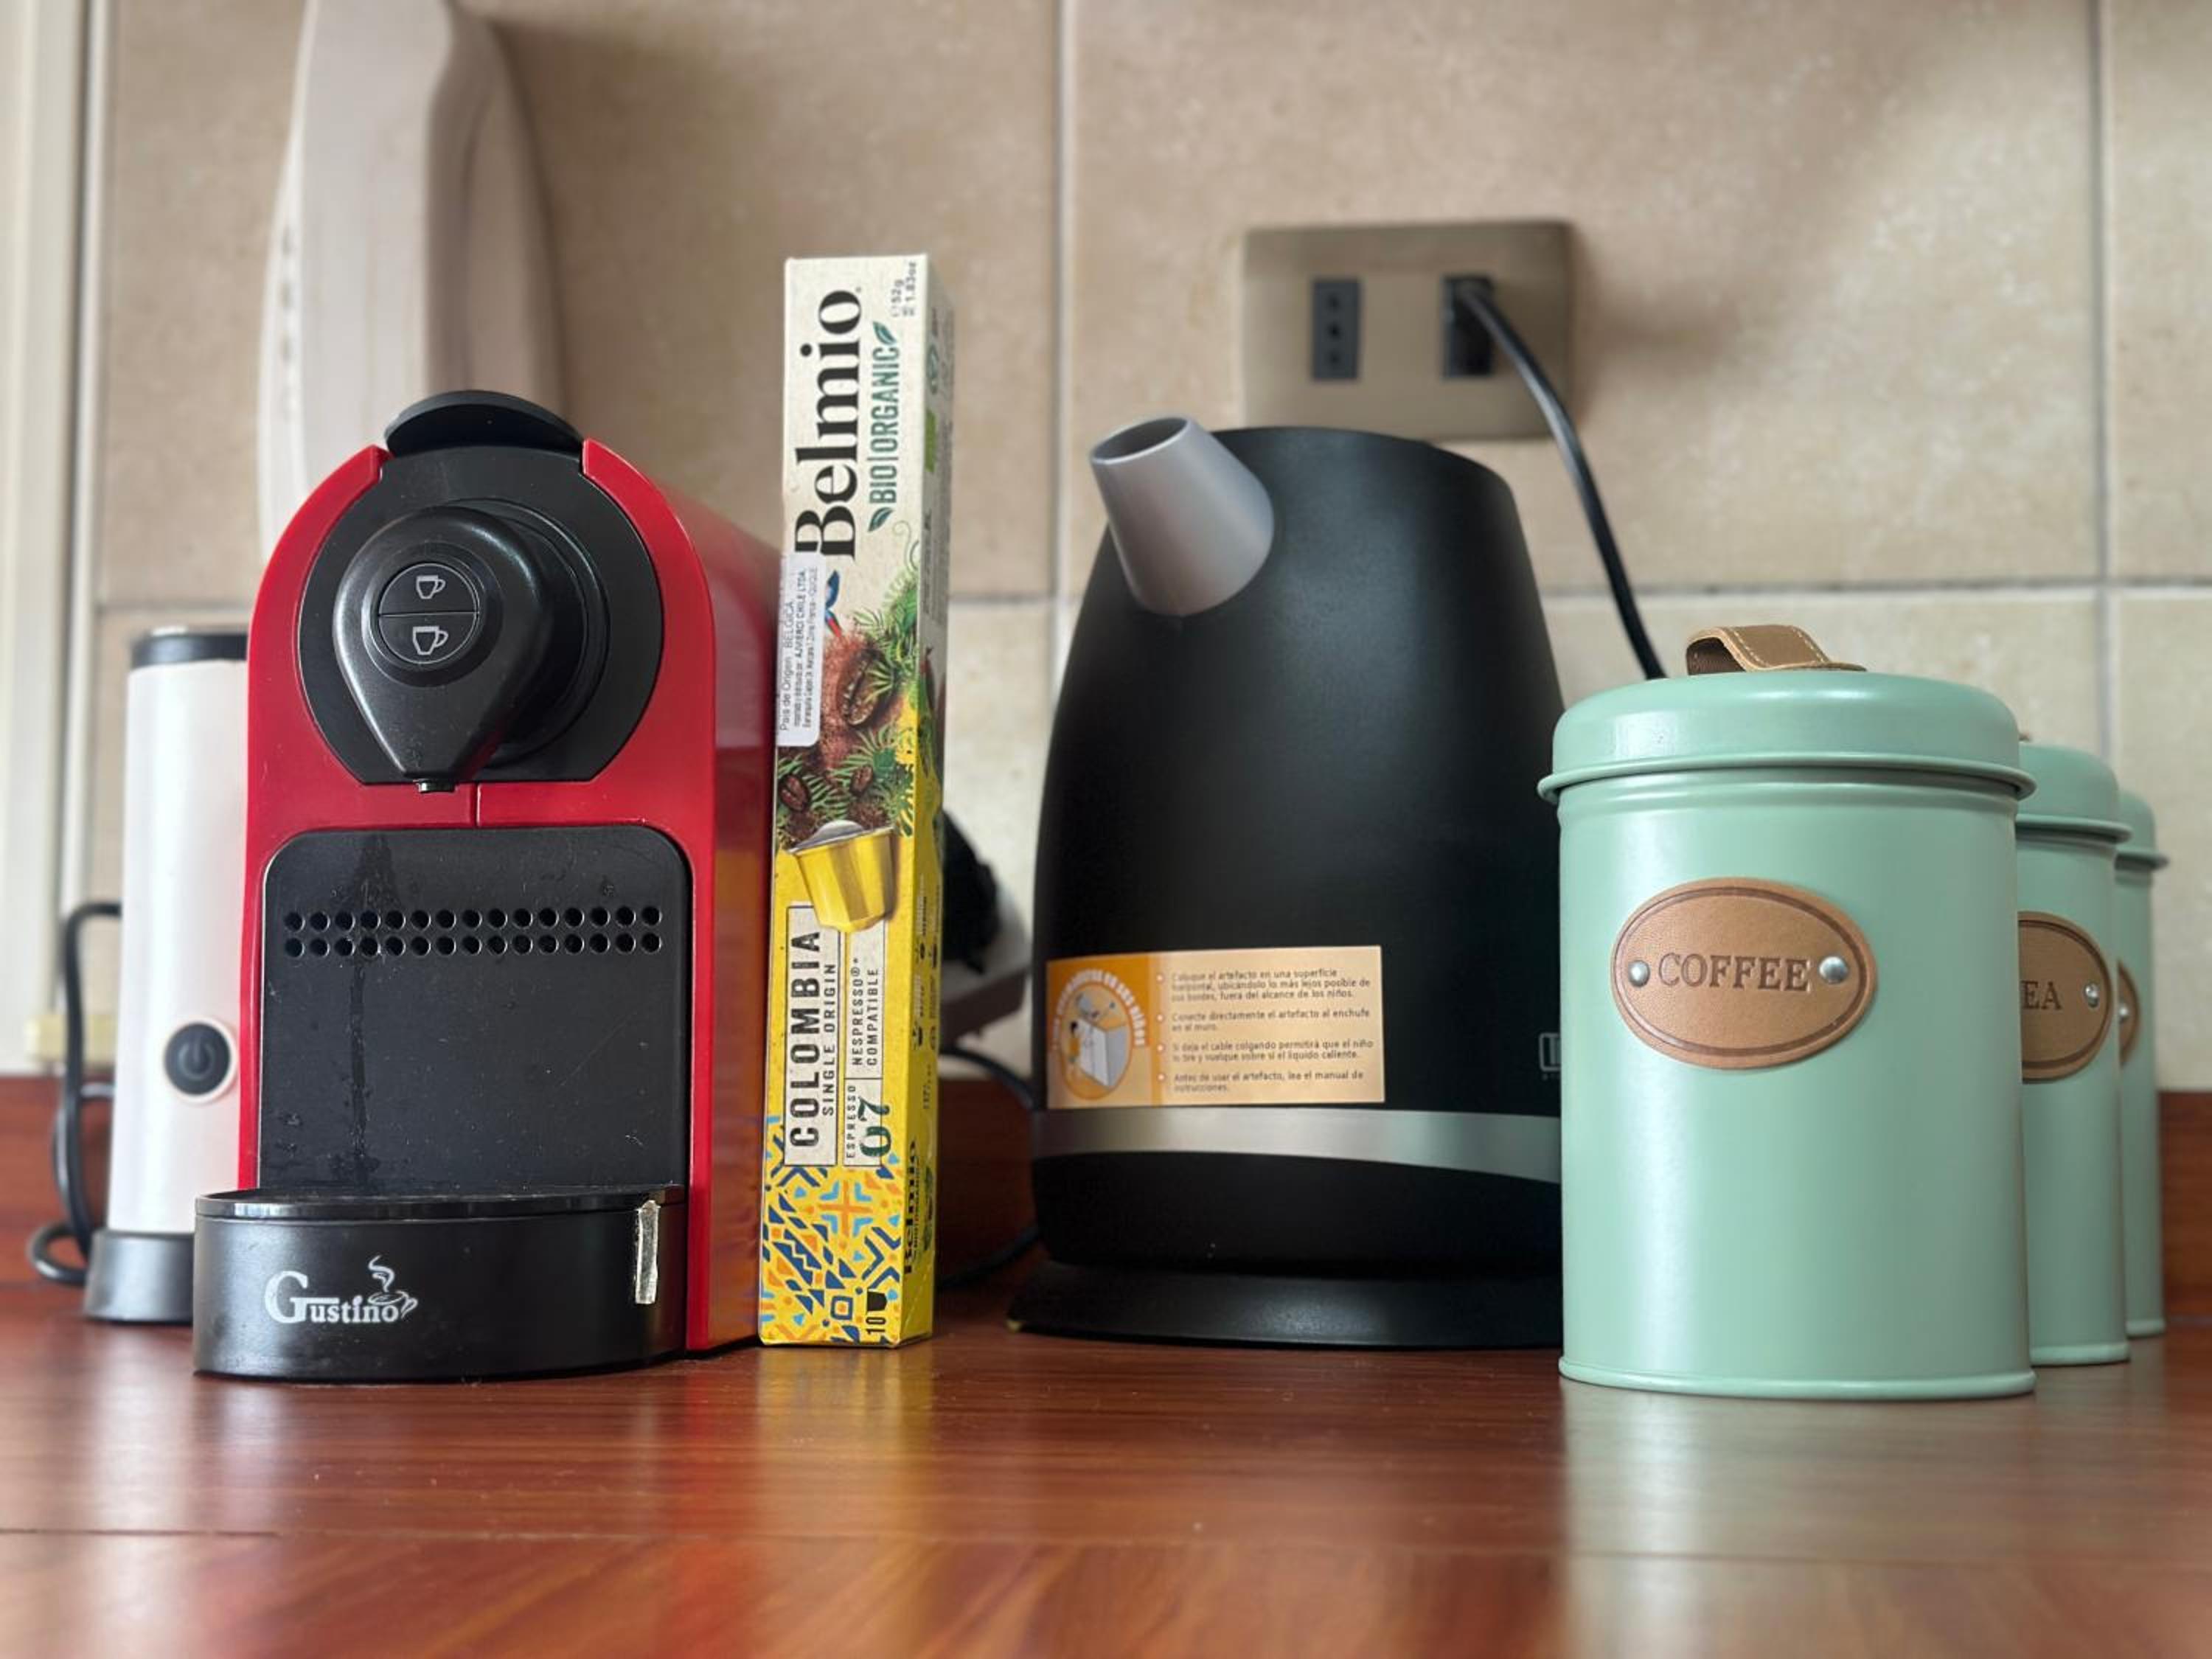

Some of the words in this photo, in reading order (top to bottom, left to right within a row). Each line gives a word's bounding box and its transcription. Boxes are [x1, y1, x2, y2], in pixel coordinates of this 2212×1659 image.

[795, 290, 861, 561] Belmio
[824, 964, 836, 1033] ORIGIN
[1658, 952, 1809, 991] COFFEE
[2021, 980, 2062, 1010] EA
[790, 932, 820, 1147] COLOMBIA
[867, 968, 878, 1066] COMPATIBLE
[821, 1043, 835, 1116] SINGLE
[846, 1085, 856, 1159] ESPRESSO
[858, 1096, 891, 1158] 07
[265, 1270, 400, 1324] Gustino
[866, 1316, 886, 1335] 10
